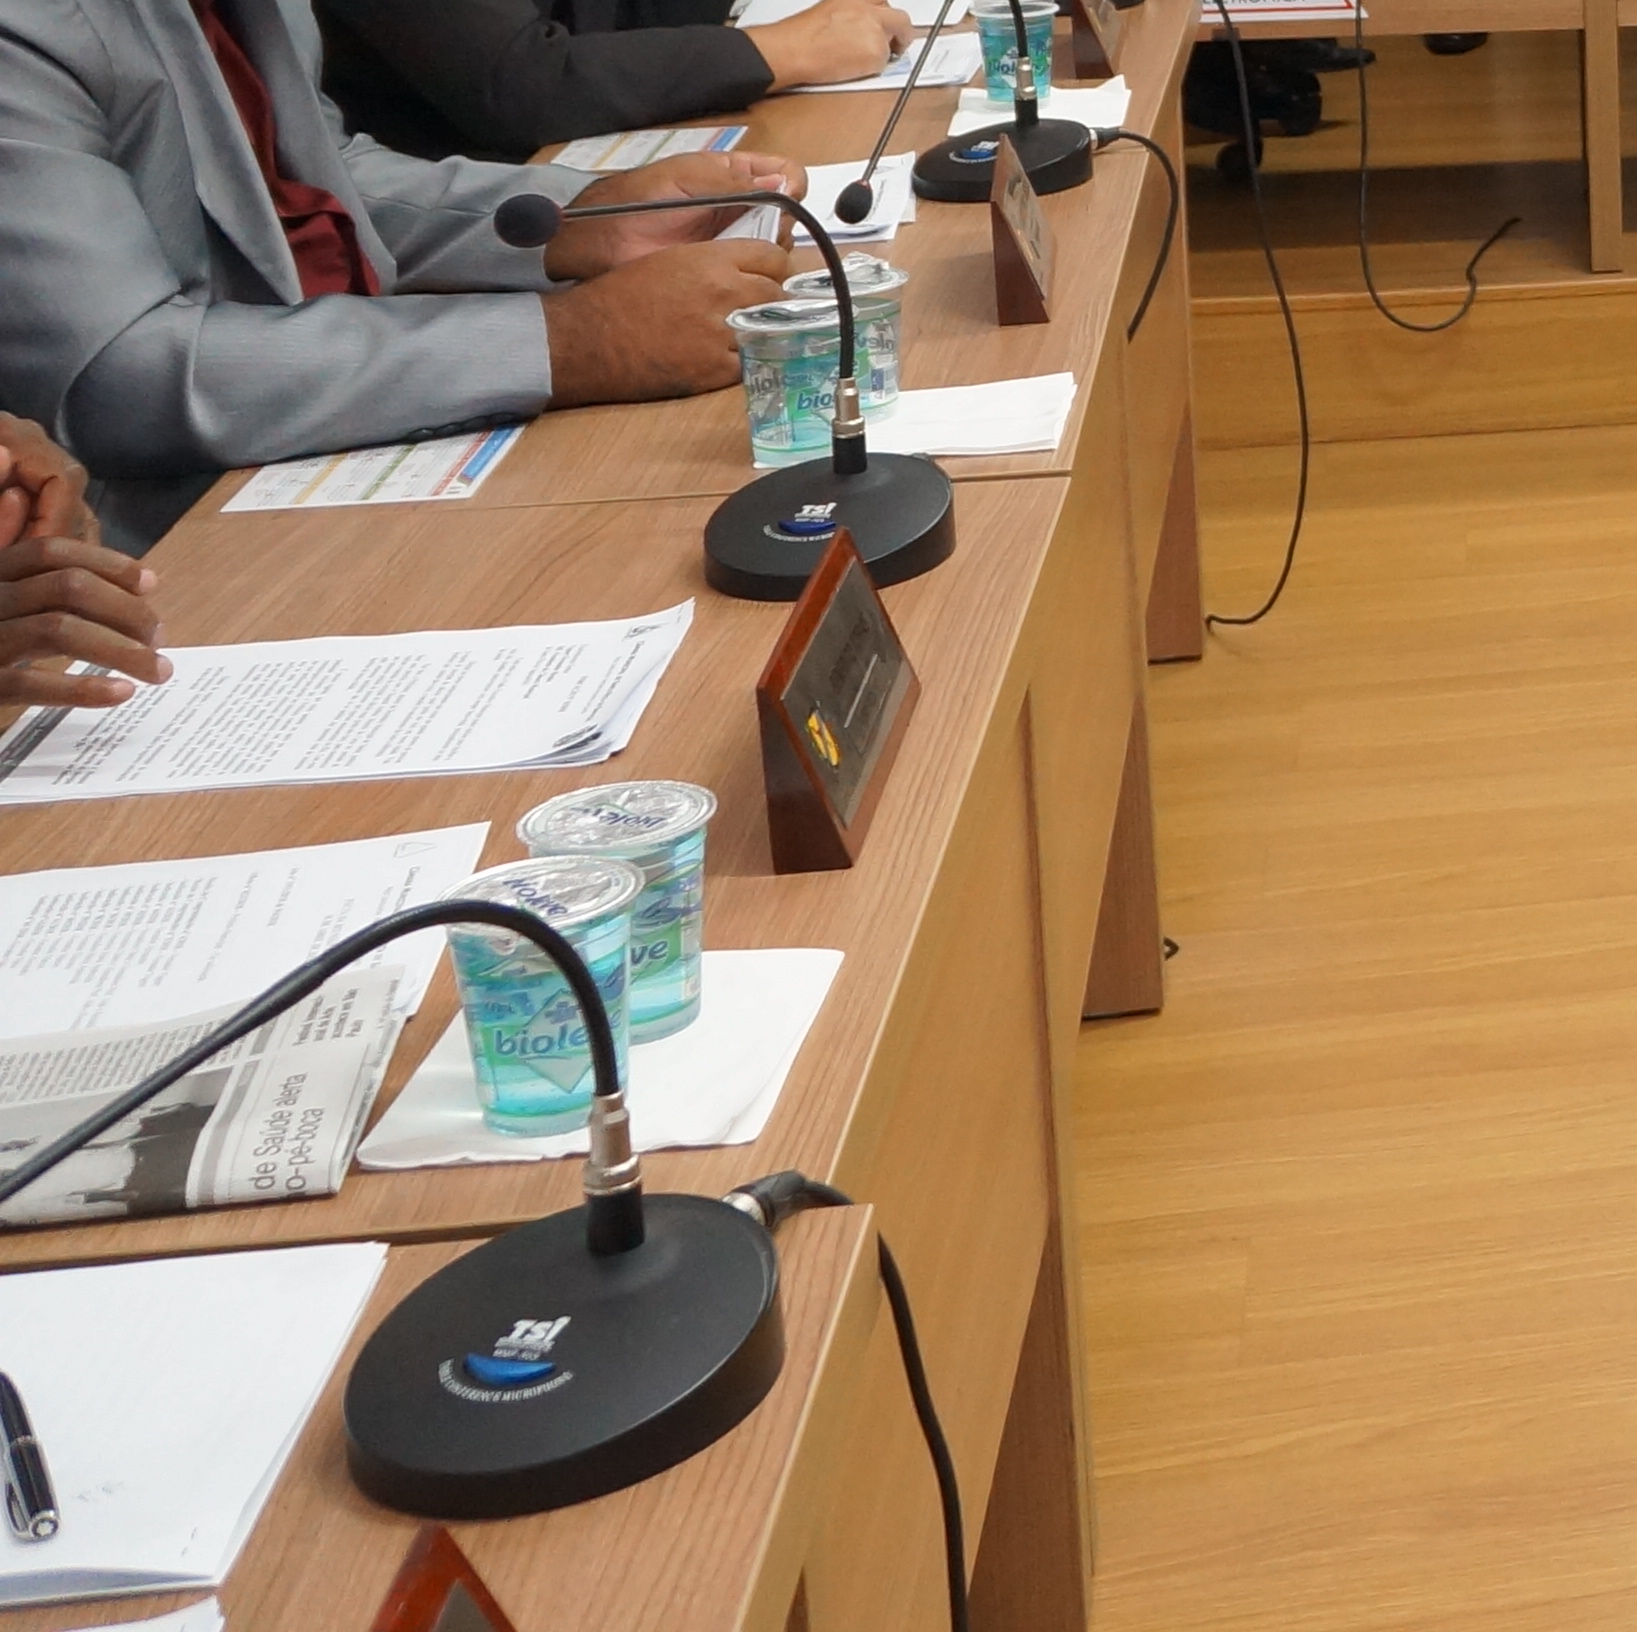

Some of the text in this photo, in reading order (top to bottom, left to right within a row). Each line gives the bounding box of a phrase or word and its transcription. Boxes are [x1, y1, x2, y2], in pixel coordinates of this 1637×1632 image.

[247, 1071, 308, 1191] de Saúde alerta
[283, 1107, 325, 1197] o-pé-boca
